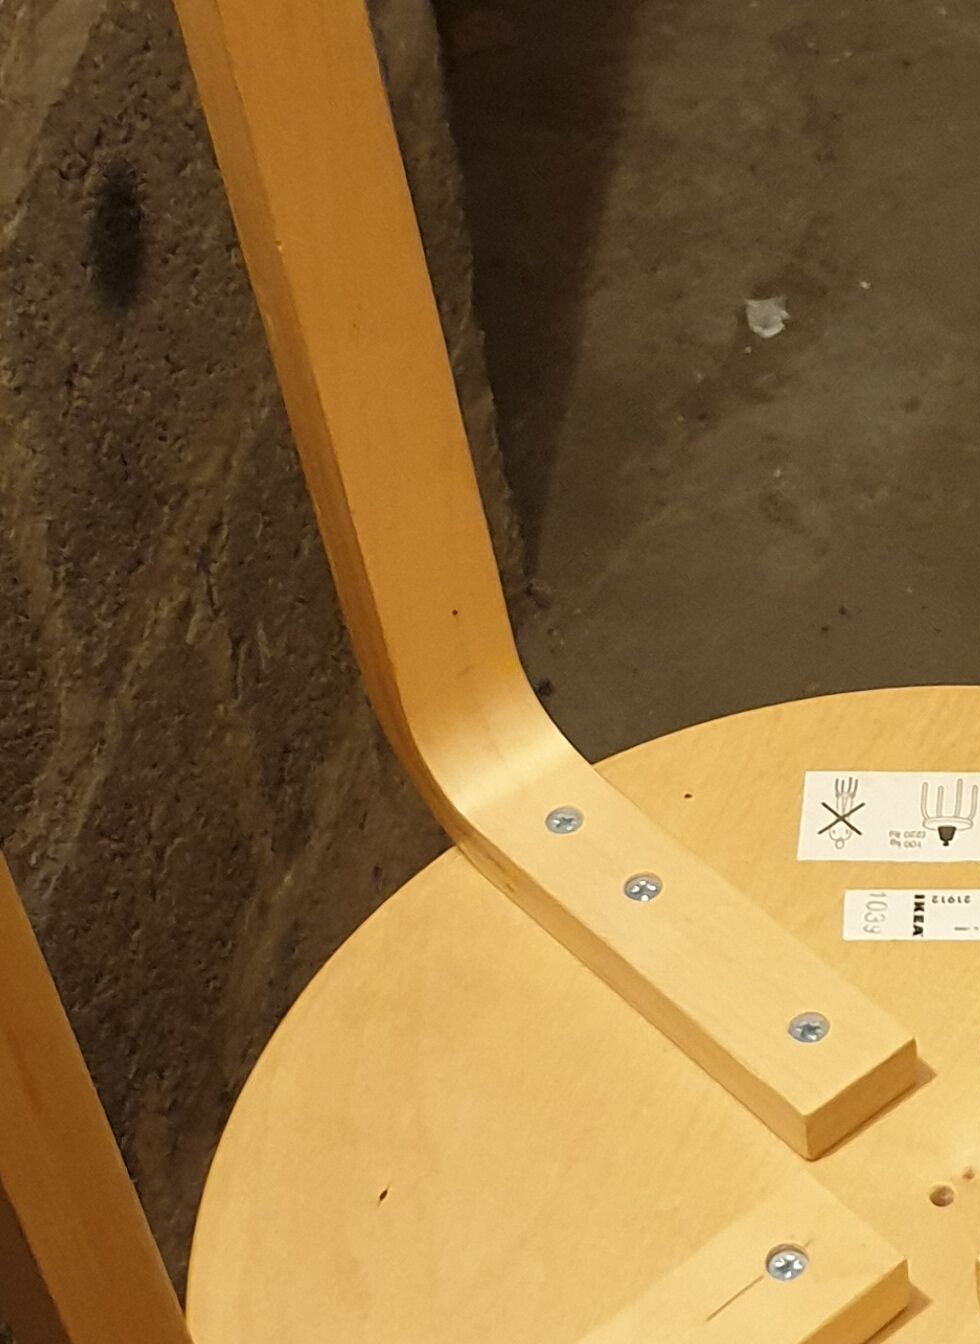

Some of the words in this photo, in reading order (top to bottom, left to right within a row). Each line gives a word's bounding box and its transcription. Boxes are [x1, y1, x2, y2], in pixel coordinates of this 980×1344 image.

[903, 840, 921, 849] 100
[931, 895, 971, 904] 21912
[863, 892, 888, 934] 1039
[912, 894, 926, 936] IKEA
